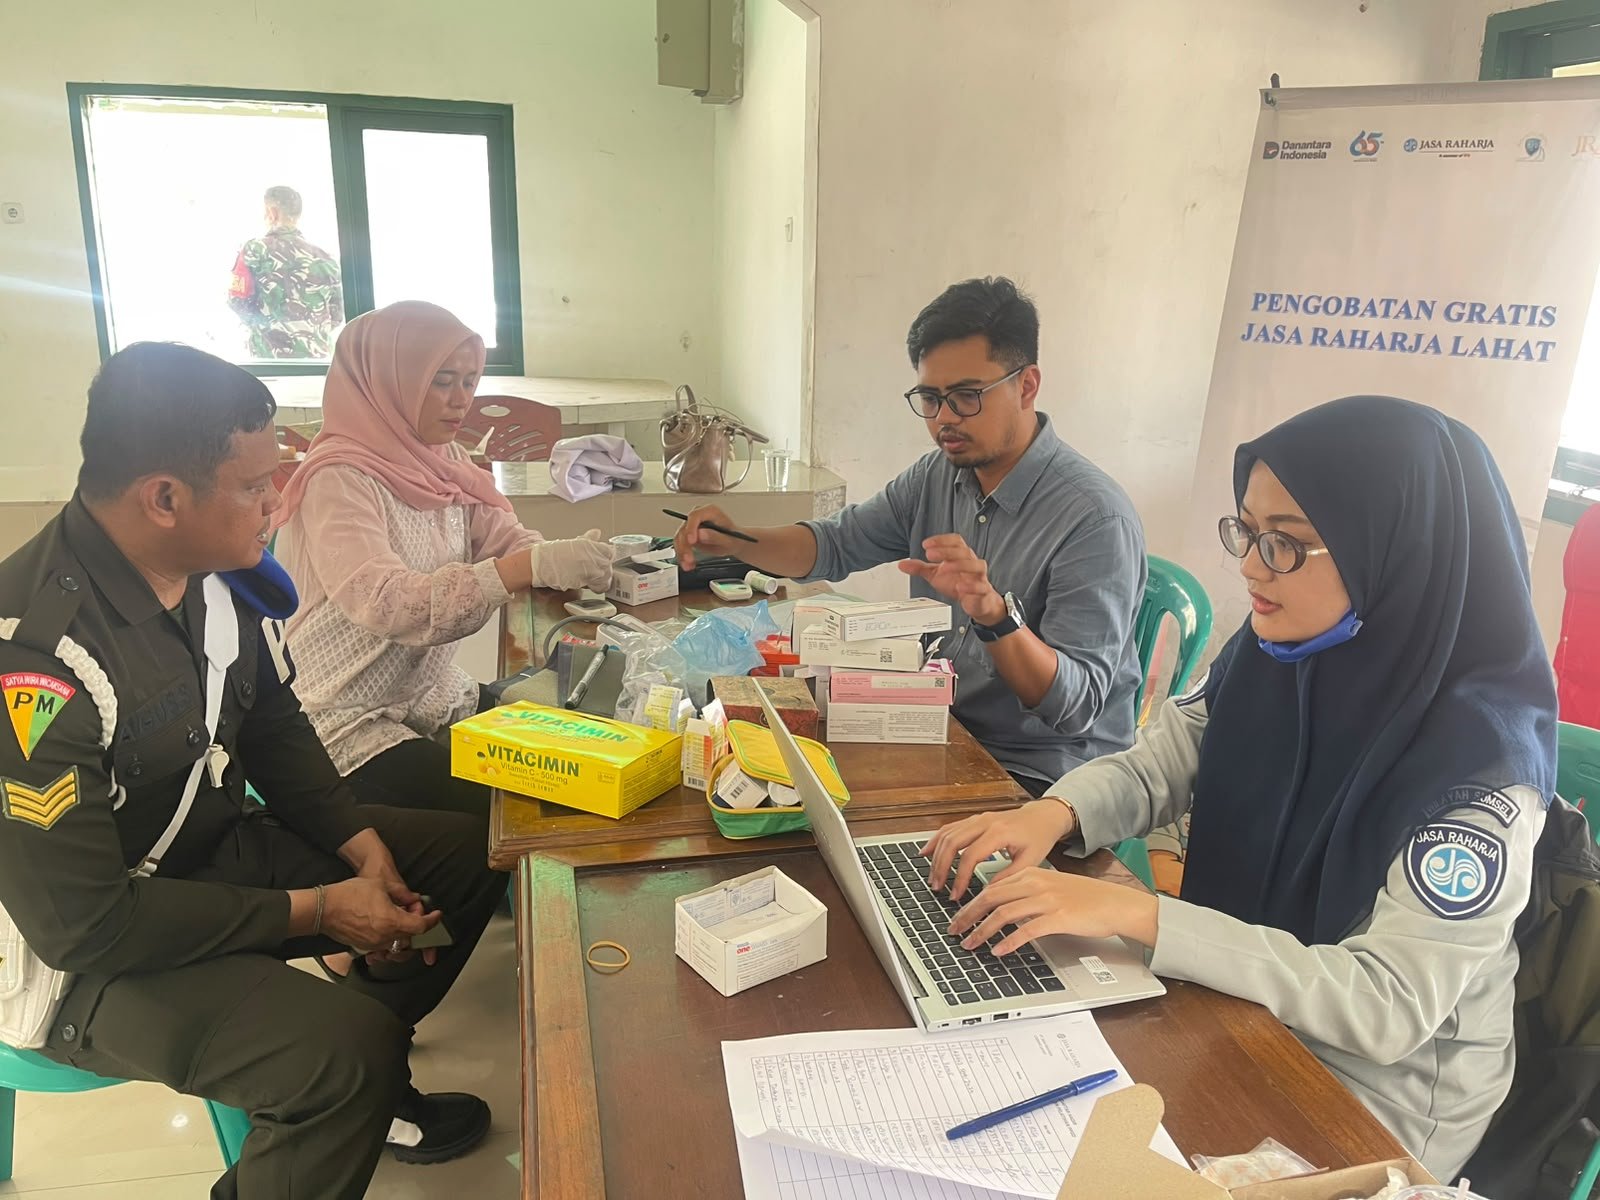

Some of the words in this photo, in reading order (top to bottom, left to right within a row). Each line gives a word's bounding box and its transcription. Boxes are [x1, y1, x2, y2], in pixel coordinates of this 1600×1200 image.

[1280, 150, 1327, 160] Indonesia
[1282, 140, 1331, 150] Danantara
[1419, 140, 1442, 150] JASA
[1445, 139, 1494, 150] RAHARJA
[1251, 292, 1437, 321] PENGOBATAN
[1443, 301, 1557, 328] GRATIS
[1241, 323, 1303, 346] JASA
[1310, 327, 1442, 356] RAHARJA
[1448, 336, 1556, 363] LAHAT
[13, 691, 55, 715] PM
[520, 711, 629, 742] VITACIMIN
[487, 743, 579, 777] VITACIMIN
[501, 762, 528, 774] Vitamin
[529, 768, 535, 776] C
[541, 771, 555, 780] 500
[556, 776, 568, 785] mg
[1416, 830, 1445, 843] JASA
[1448, 831, 1498, 862] RAHARJA
